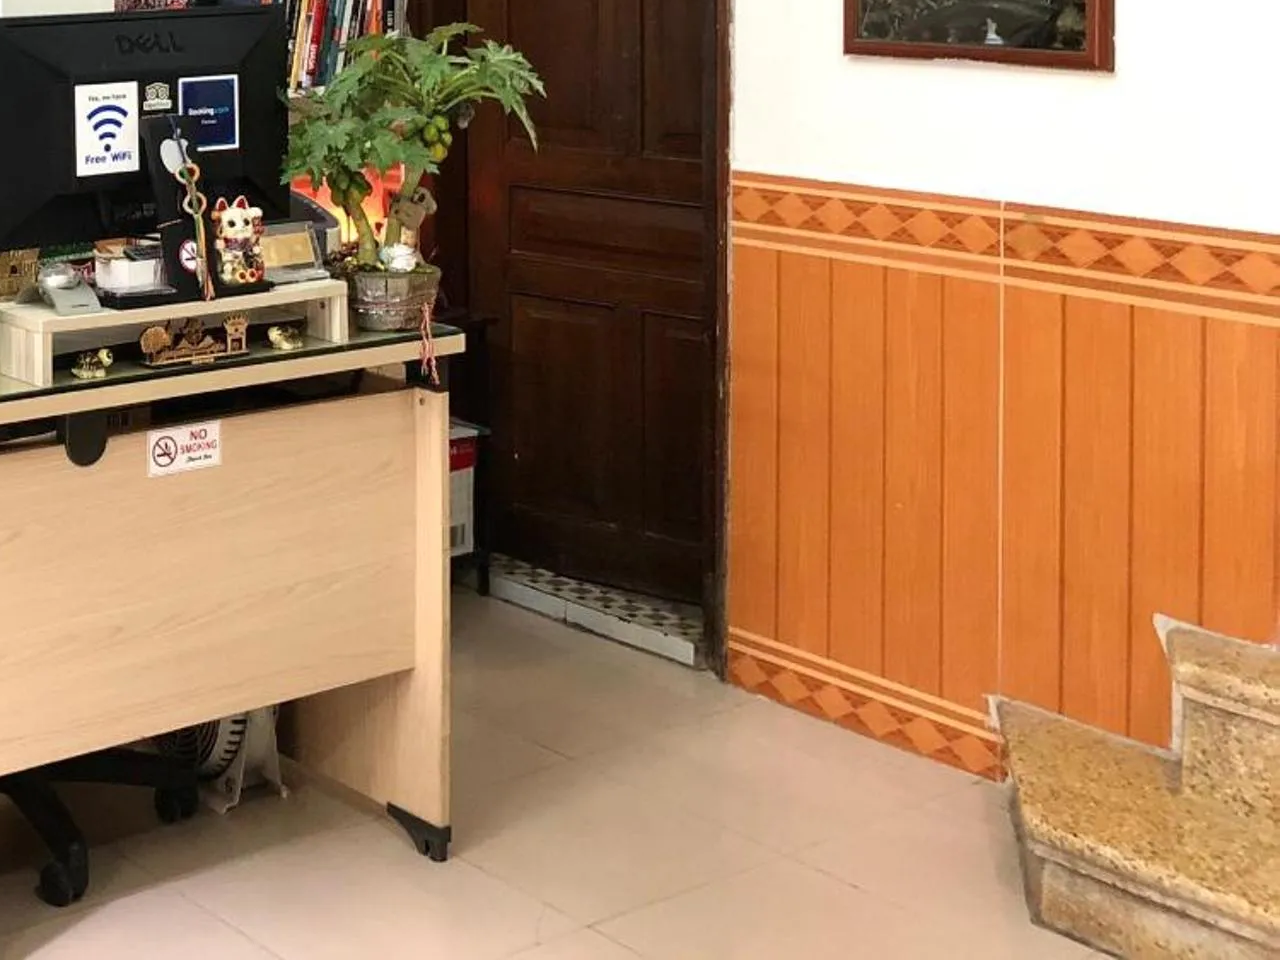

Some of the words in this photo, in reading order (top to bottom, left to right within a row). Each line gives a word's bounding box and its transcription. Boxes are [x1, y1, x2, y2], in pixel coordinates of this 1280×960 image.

[116, 32, 184, 54] DELL
[84, 154, 107, 165] Free
[111, 151, 133, 162] WiFi
[189, 428, 208, 440] NO
[179, 440, 217, 454] SMOKING
